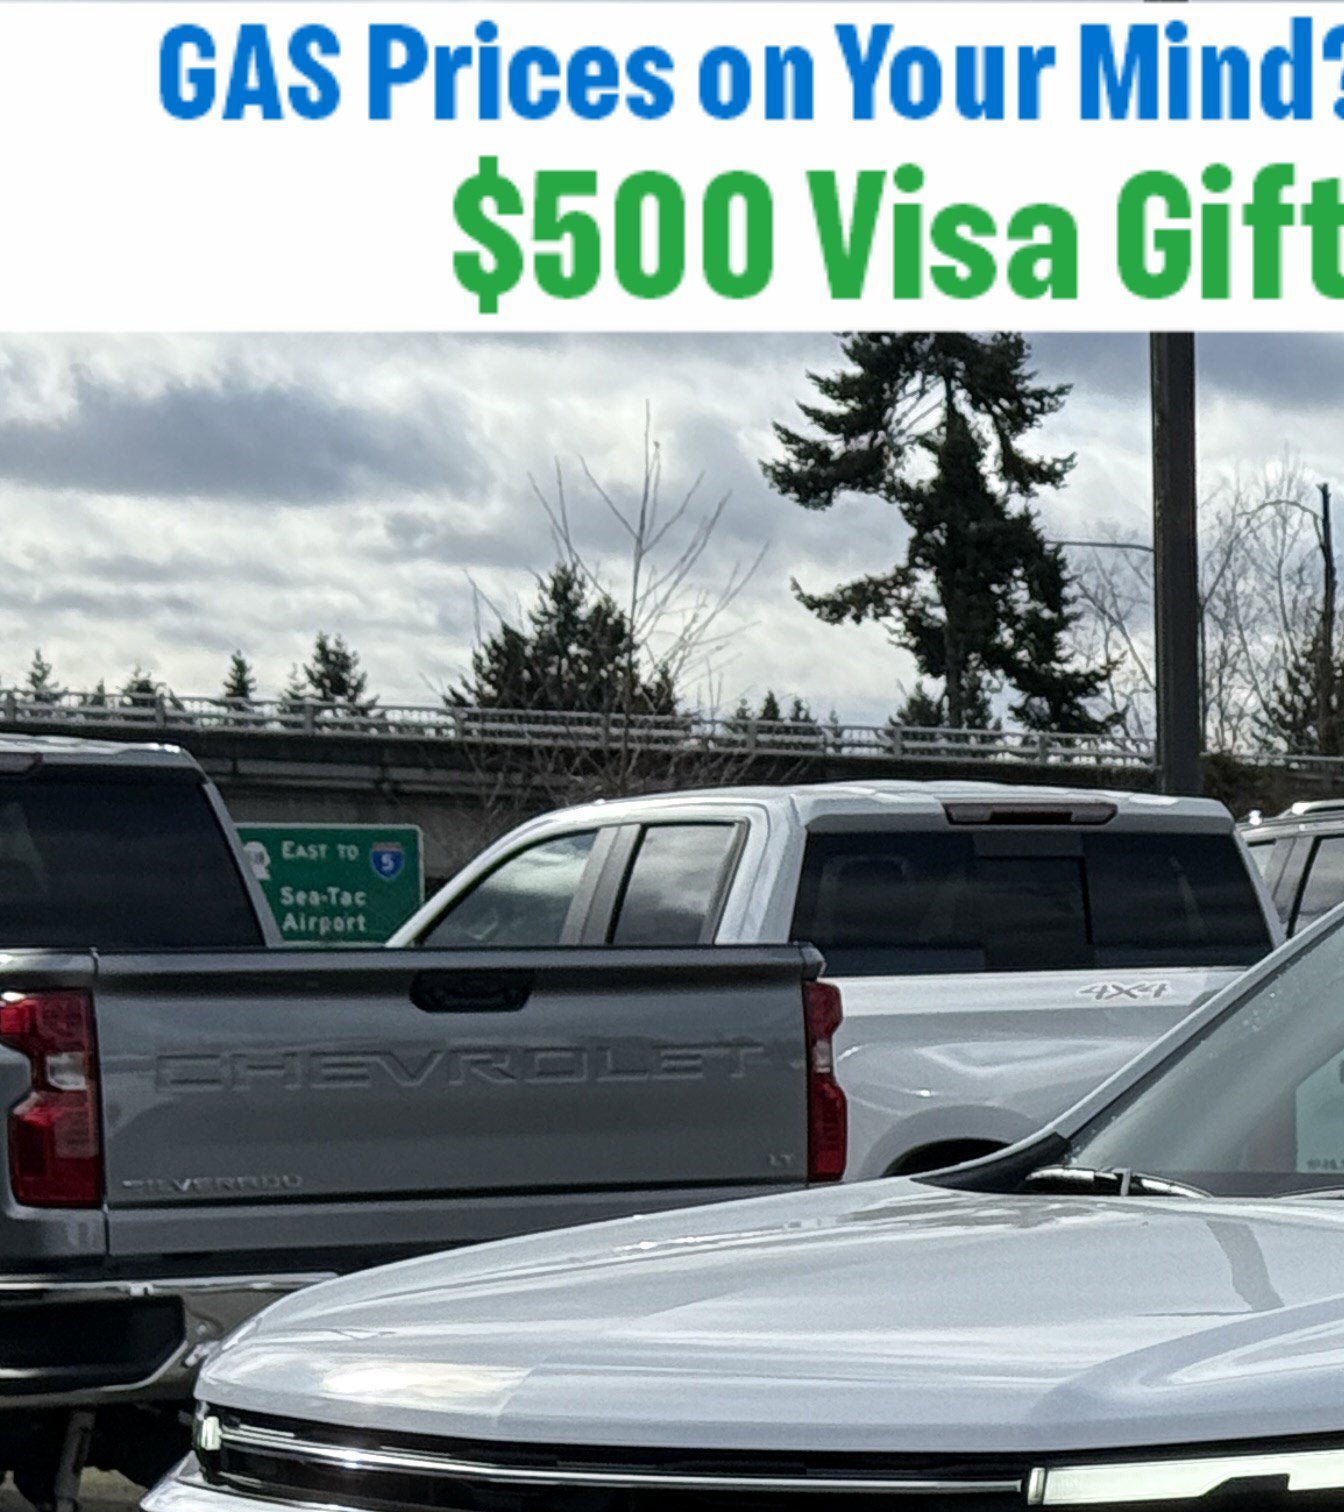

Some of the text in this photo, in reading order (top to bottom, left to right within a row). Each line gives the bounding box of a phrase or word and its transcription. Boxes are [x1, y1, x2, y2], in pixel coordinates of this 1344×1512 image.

[281, 840, 329, 860] EAST
[280, 886, 367, 906] Sea-Tac
[282, 913, 367, 935] Airport
[154, 1045, 764, 1092] CHEVROLET
